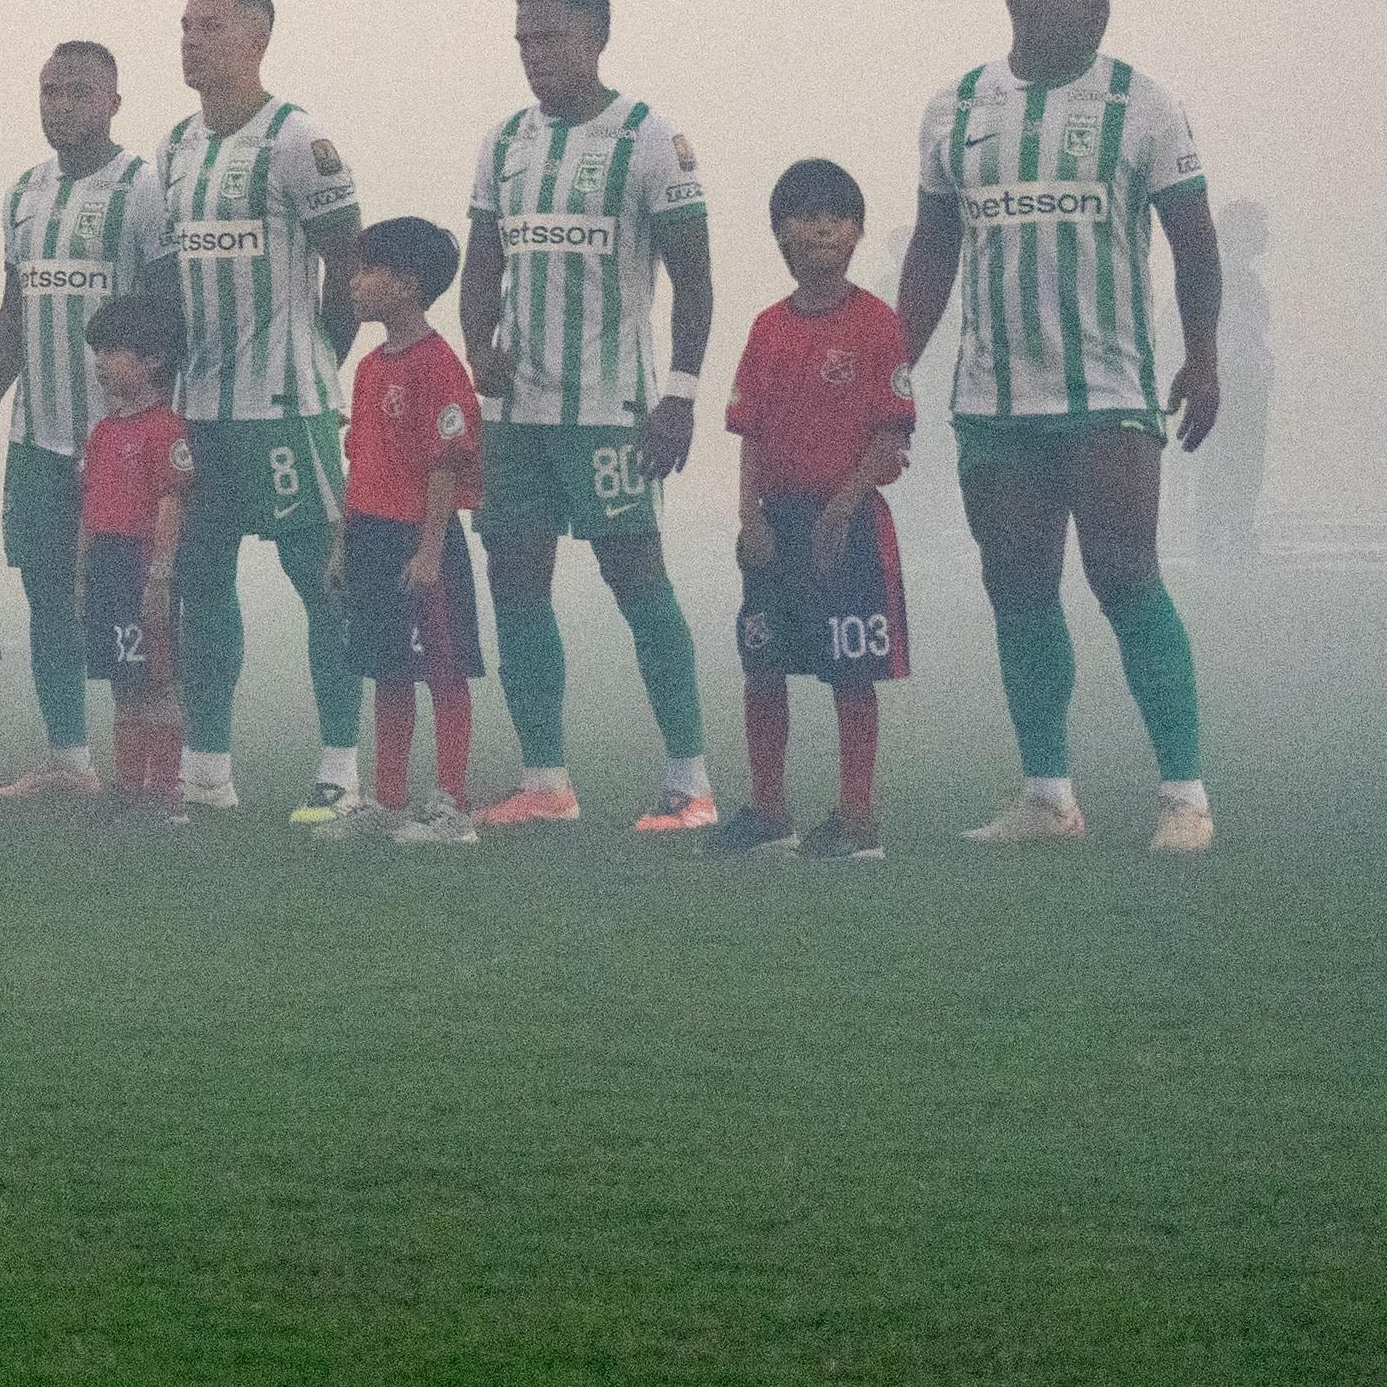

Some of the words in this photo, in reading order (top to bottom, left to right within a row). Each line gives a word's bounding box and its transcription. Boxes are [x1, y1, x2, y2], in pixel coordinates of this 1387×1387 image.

[967, 190, 1103, 220] betsson
[181, 230, 259, 253] tsson
[22, 266, 108, 289] etsson
[270, 446, 299, 495] 8
[593, 444, 645, 498] 80
[828, 613, 891, 661] 103
